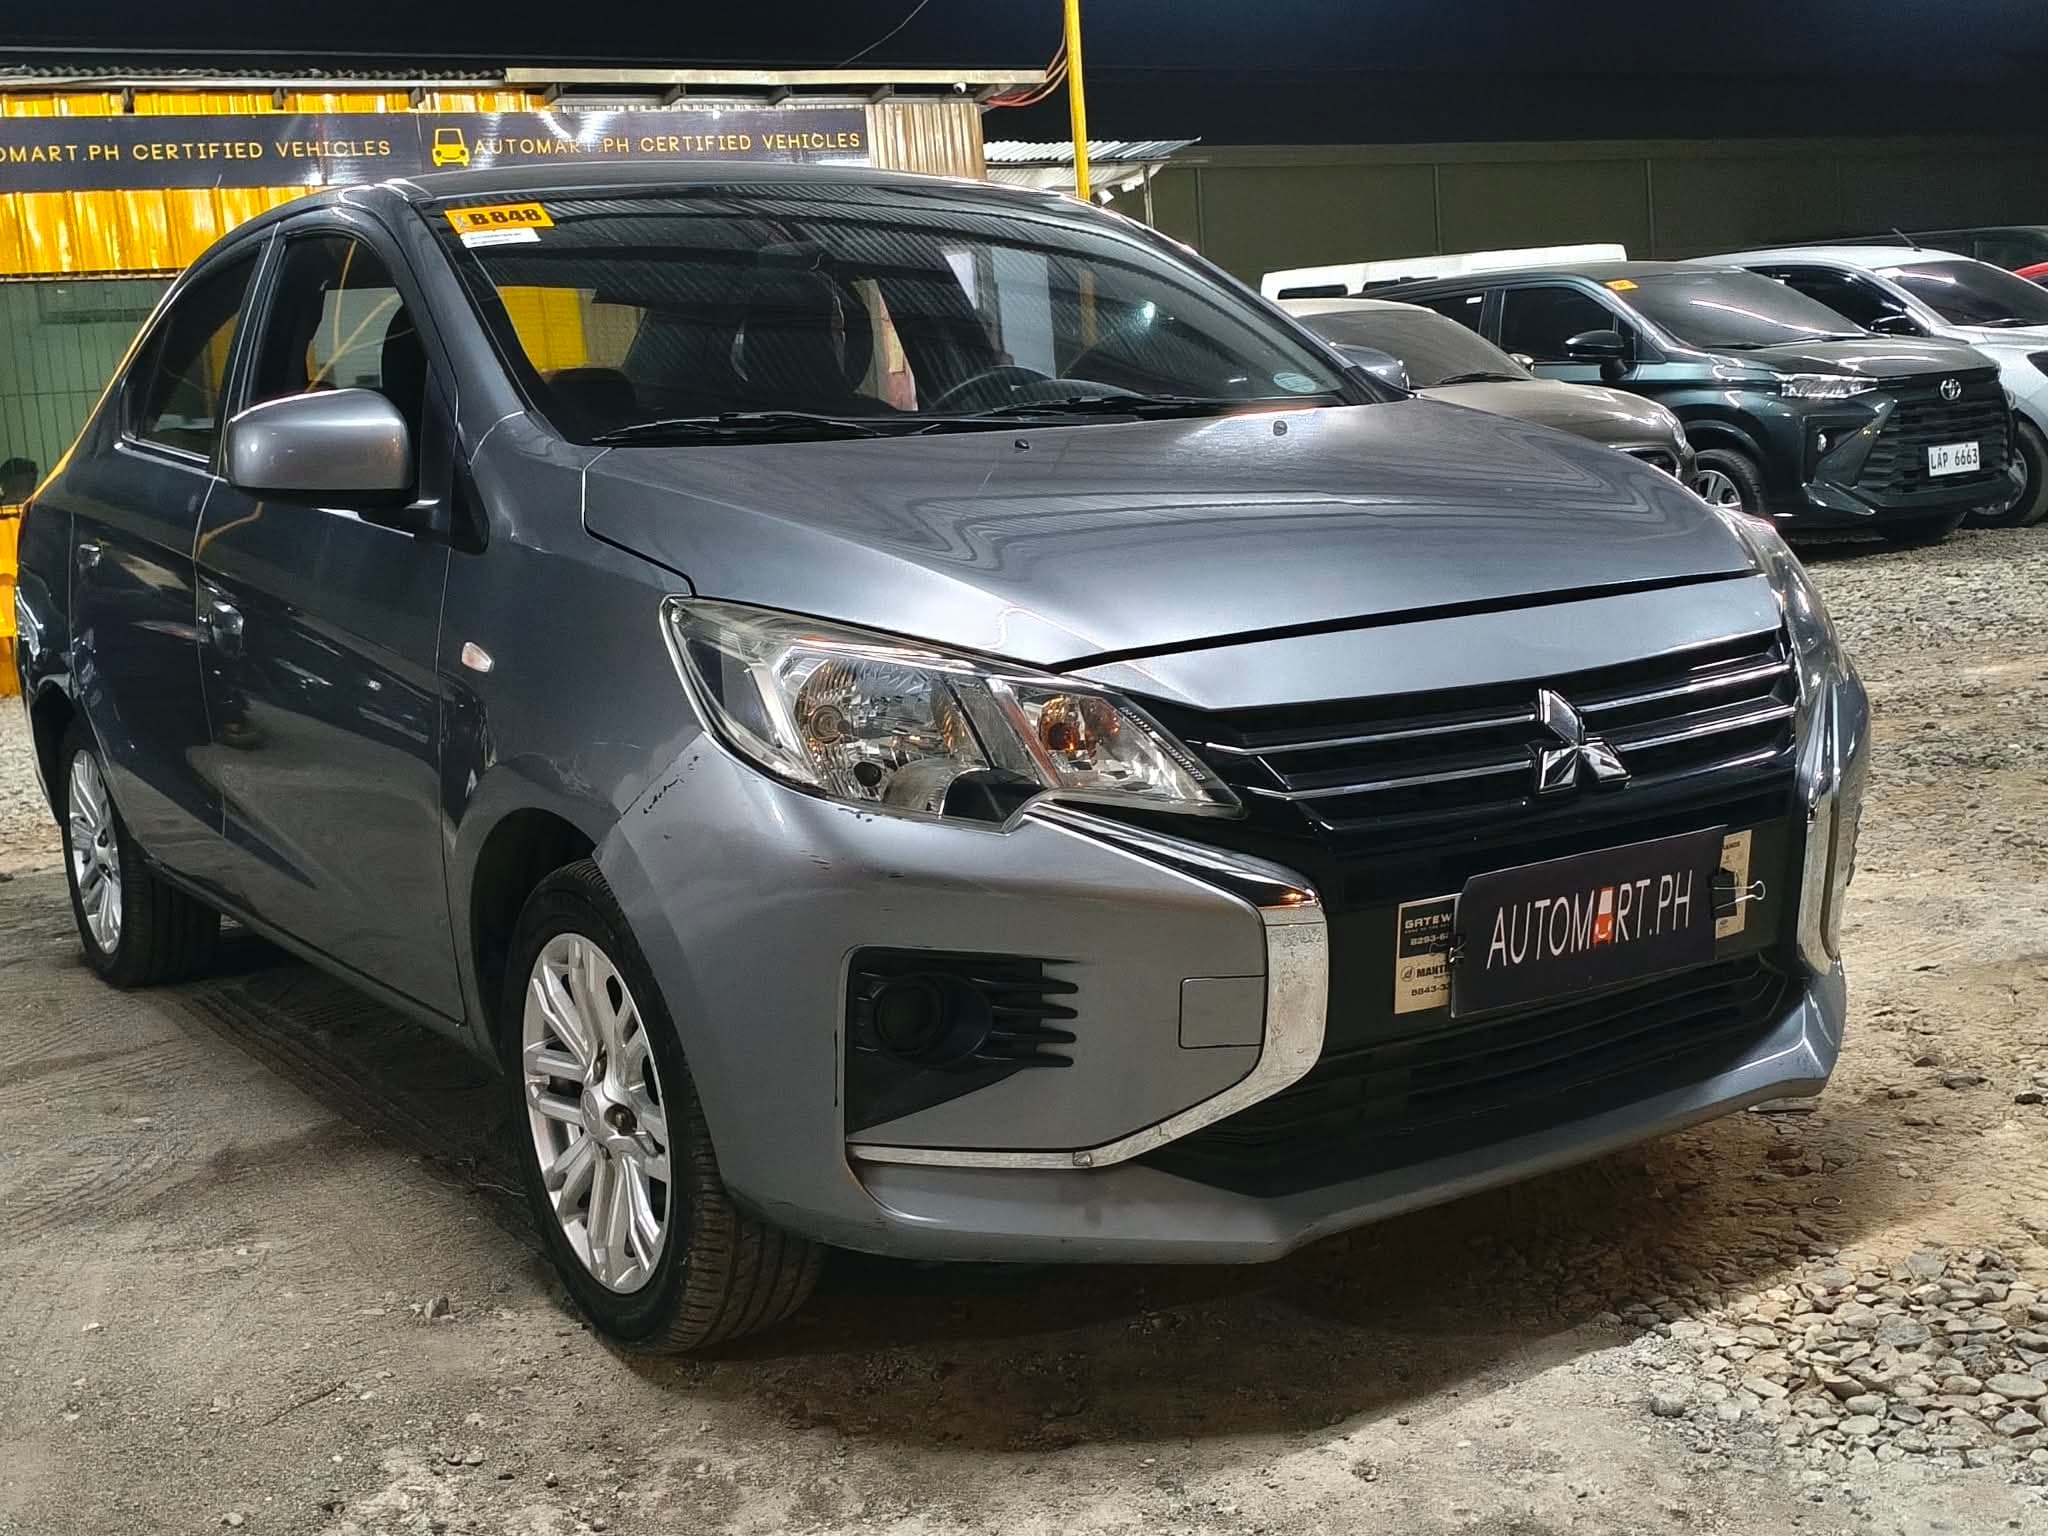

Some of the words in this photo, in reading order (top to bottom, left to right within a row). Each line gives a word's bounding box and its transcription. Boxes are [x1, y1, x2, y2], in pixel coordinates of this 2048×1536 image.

[132, 142, 263, 160] CERTIFIED
[275, 140, 391, 158] VEHICLES
[640, 134, 751, 153] CERTIFIED
[762, 132, 861, 150] VEHICLES
[1930, 452, 1949, 470] LAP
[1954, 448, 1978, 466] 6663
